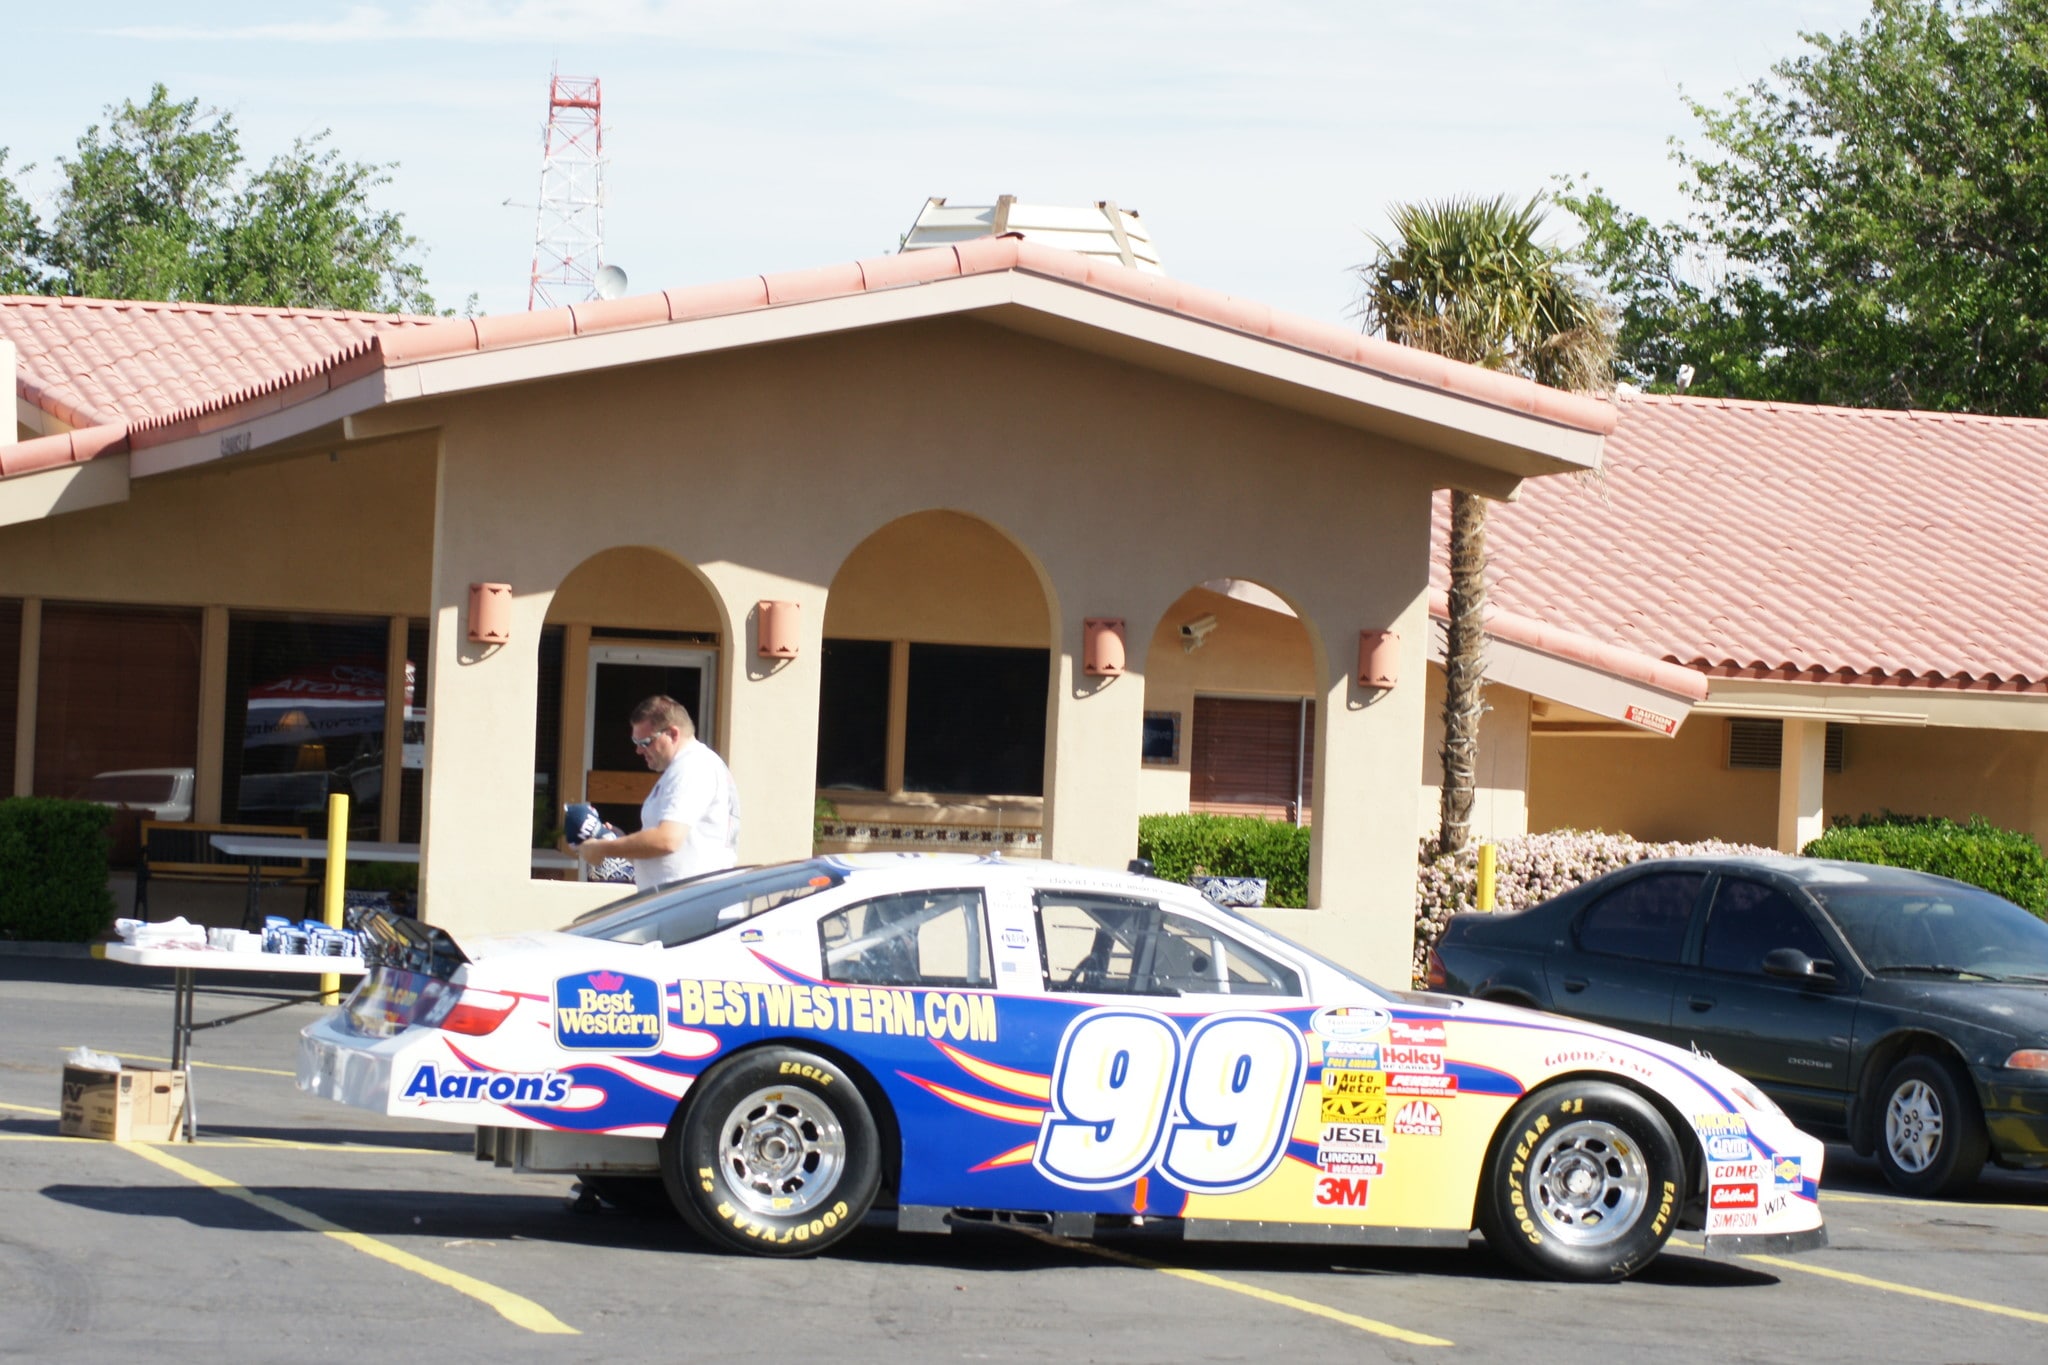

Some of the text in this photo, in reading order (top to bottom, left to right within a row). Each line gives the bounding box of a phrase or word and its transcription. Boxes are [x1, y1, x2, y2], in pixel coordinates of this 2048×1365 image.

[1631, 707, 1672, 726] CAUTION
[578, 988, 634, 1014] Best
[679, 979, 998, 1043] BESTWESTERN.COM
[558, 1008, 659, 1035] Western
[1382, 1047, 1441, 1071] Holley
[404, 1065, 569, 1102] Aaron's
[779, 1061, 833, 1087] EAGLE
[1340, 1073, 1375, 1083] Auto
[1035, 1008, 1306, 1193] 99
[1337, 1083, 1381, 1095] Meter
[1394, 1100, 1441, 1126] MAC
[1323, 1127, 1384, 1144] JESEL
[1394, 1125, 1441, 1136] TOOLS
[1321, 1152, 1375, 1165] LINCOLN
[1508, 1098, 1584, 1245] GOODYEAR #1
[1714, 1165, 1758, 1178] COMP
[1316, 1177, 1368, 1206] 3M
[1650, 1181, 1676, 1237] EAGLE
[1764, 1195, 1787, 1216] WIX
[717, 1201, 849, 1244] GOODYEAR
[1712, 1213, 1758, 1229] SIMPSON
